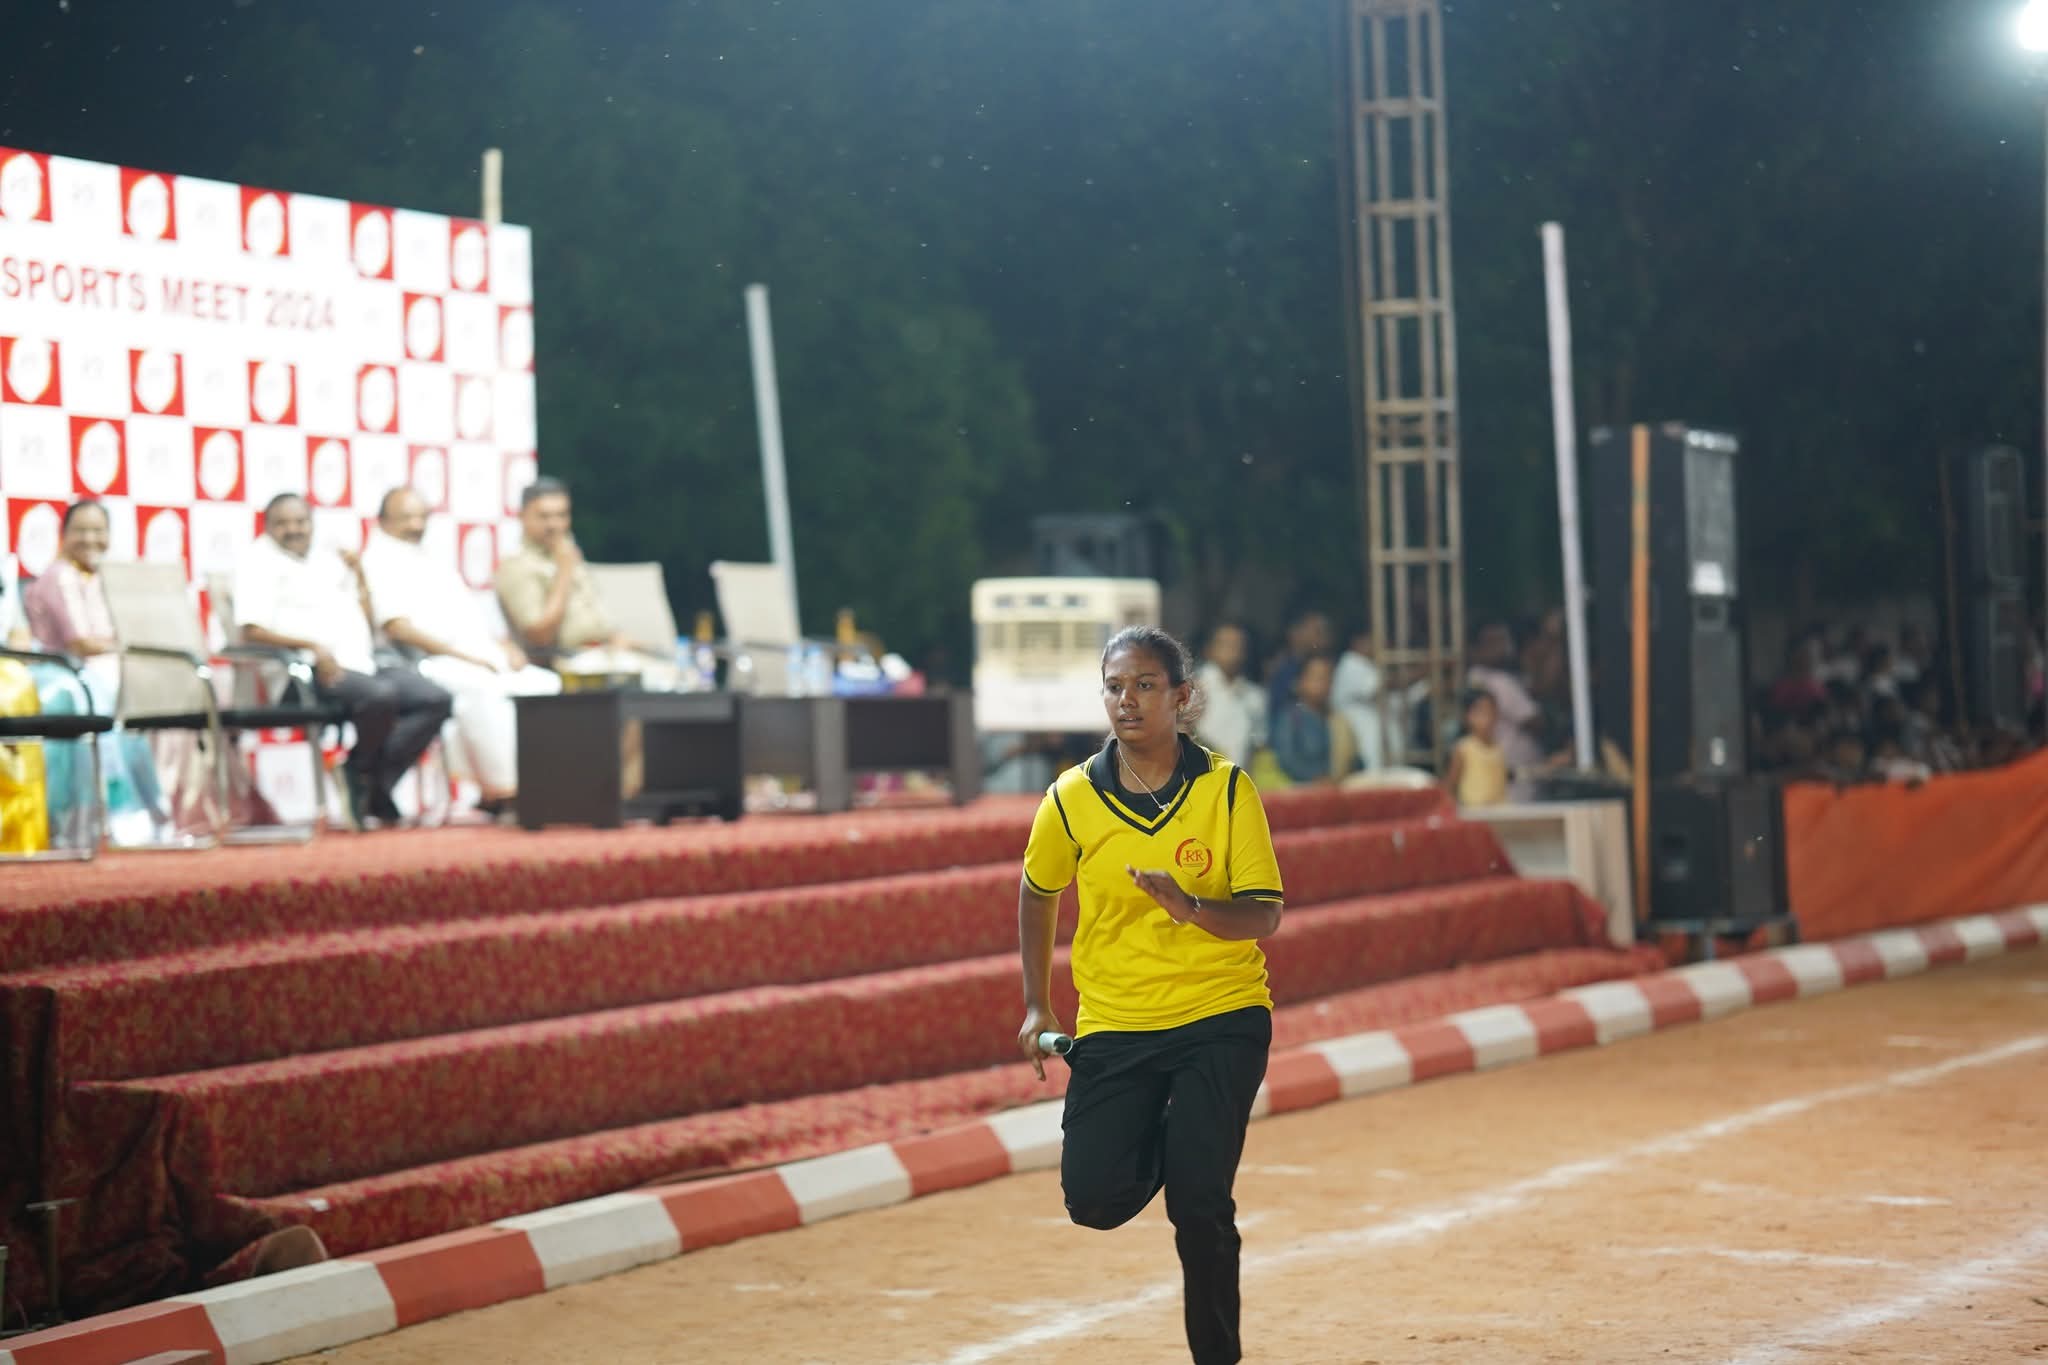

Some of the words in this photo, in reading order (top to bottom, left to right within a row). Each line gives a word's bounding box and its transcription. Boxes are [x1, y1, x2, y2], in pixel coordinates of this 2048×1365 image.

[2, 257, 147, 312] SPORTS
[162, 277, 250, 322] MEET
[265, 288, 336, 331] 2024
